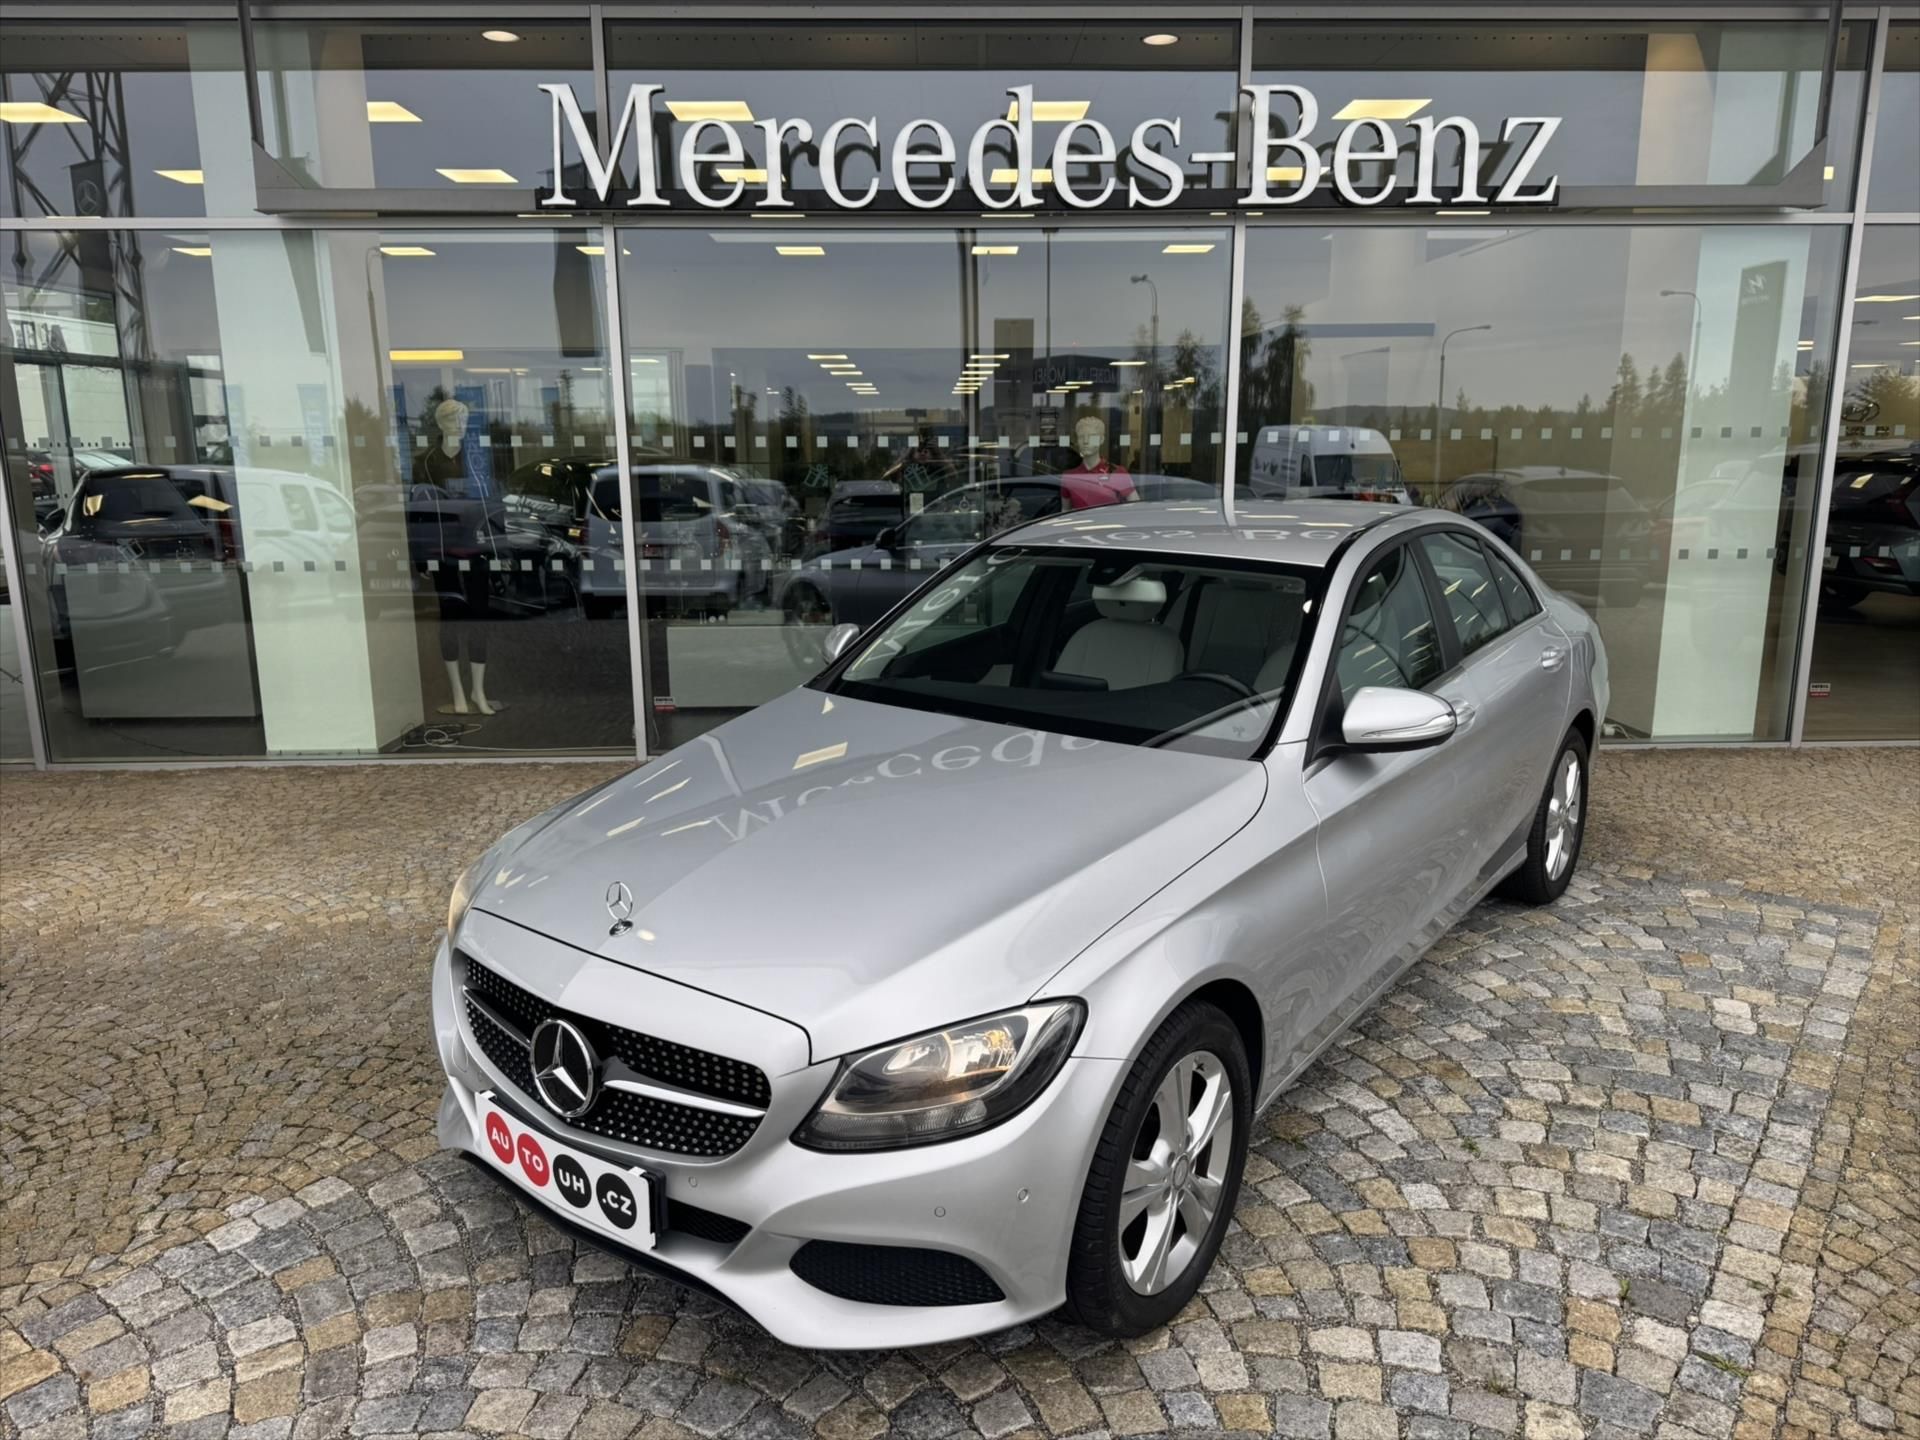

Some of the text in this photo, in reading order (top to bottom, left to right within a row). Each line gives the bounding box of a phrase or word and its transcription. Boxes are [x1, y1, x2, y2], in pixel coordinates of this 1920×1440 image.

[537, 82, 1563, 209] Mercedes-Benz
[491, 1127, 632, 1216] AU TO UH .CZ
